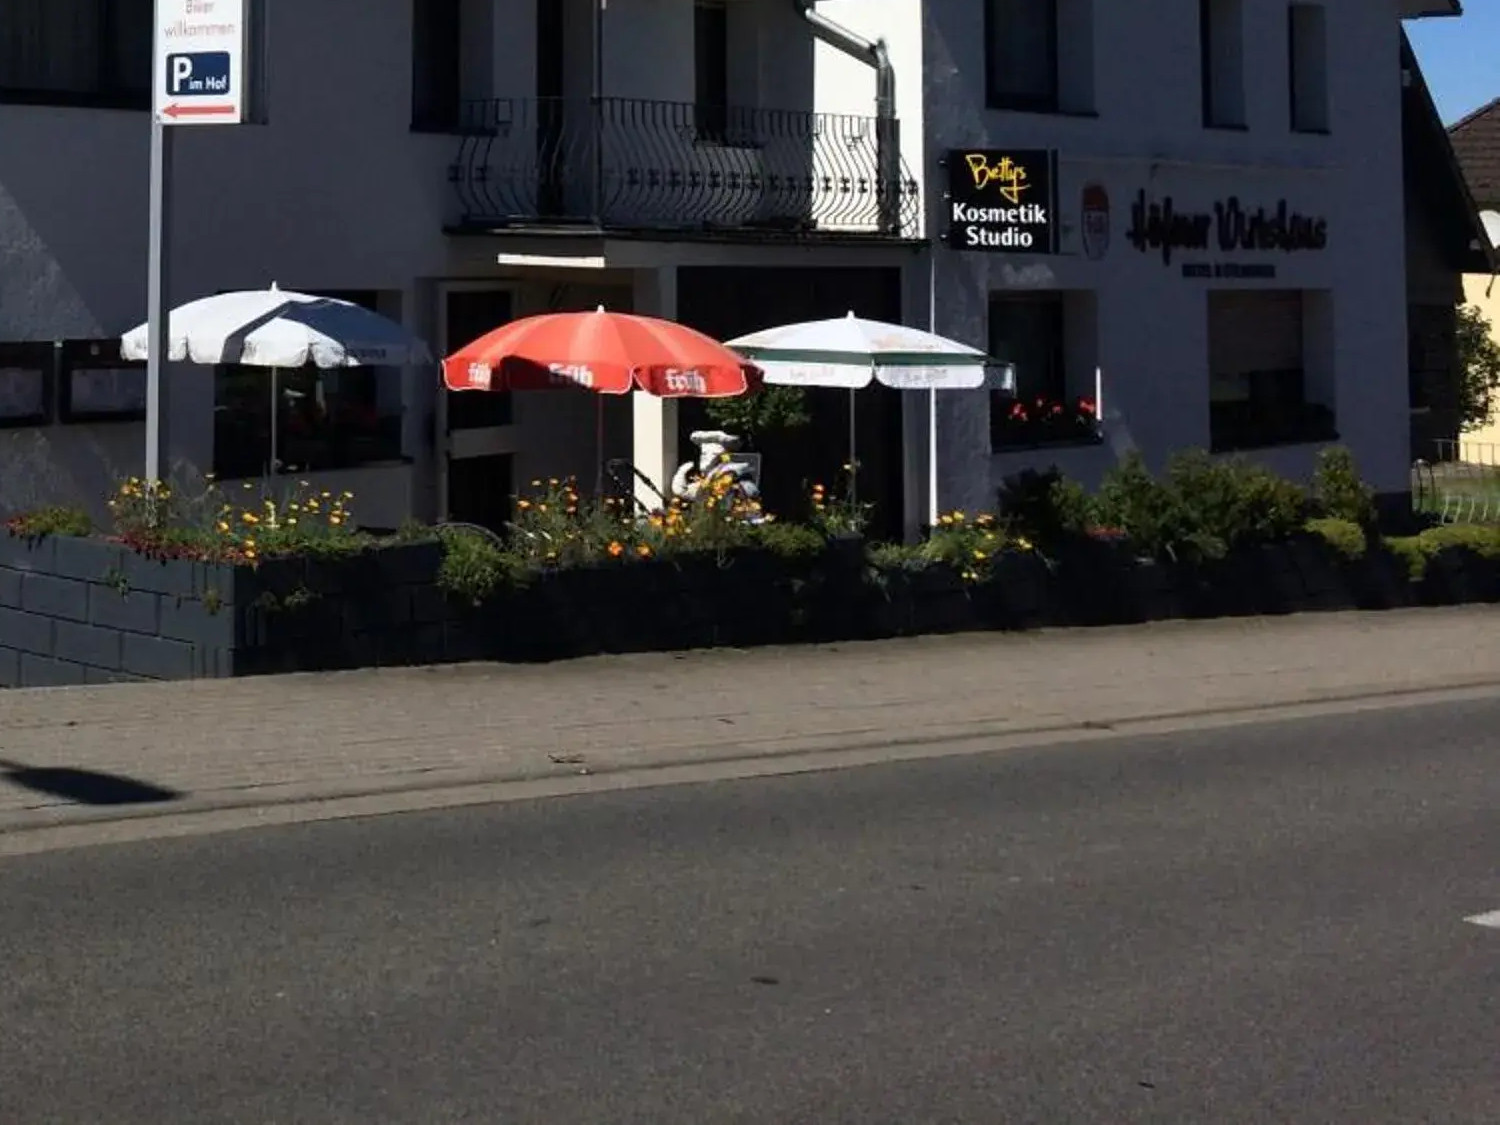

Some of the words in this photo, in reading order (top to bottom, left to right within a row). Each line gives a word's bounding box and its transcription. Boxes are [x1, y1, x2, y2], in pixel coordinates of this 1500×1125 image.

[163, 18, 236, 37] willkommen
[173, 56, 193, 92] P
[189, 76, 203, 90] im
[205, 74, 227, 90] Hof
[953, 202, 1047, 224] Kosmetik
[965, 225, 1033, 248] Studio
